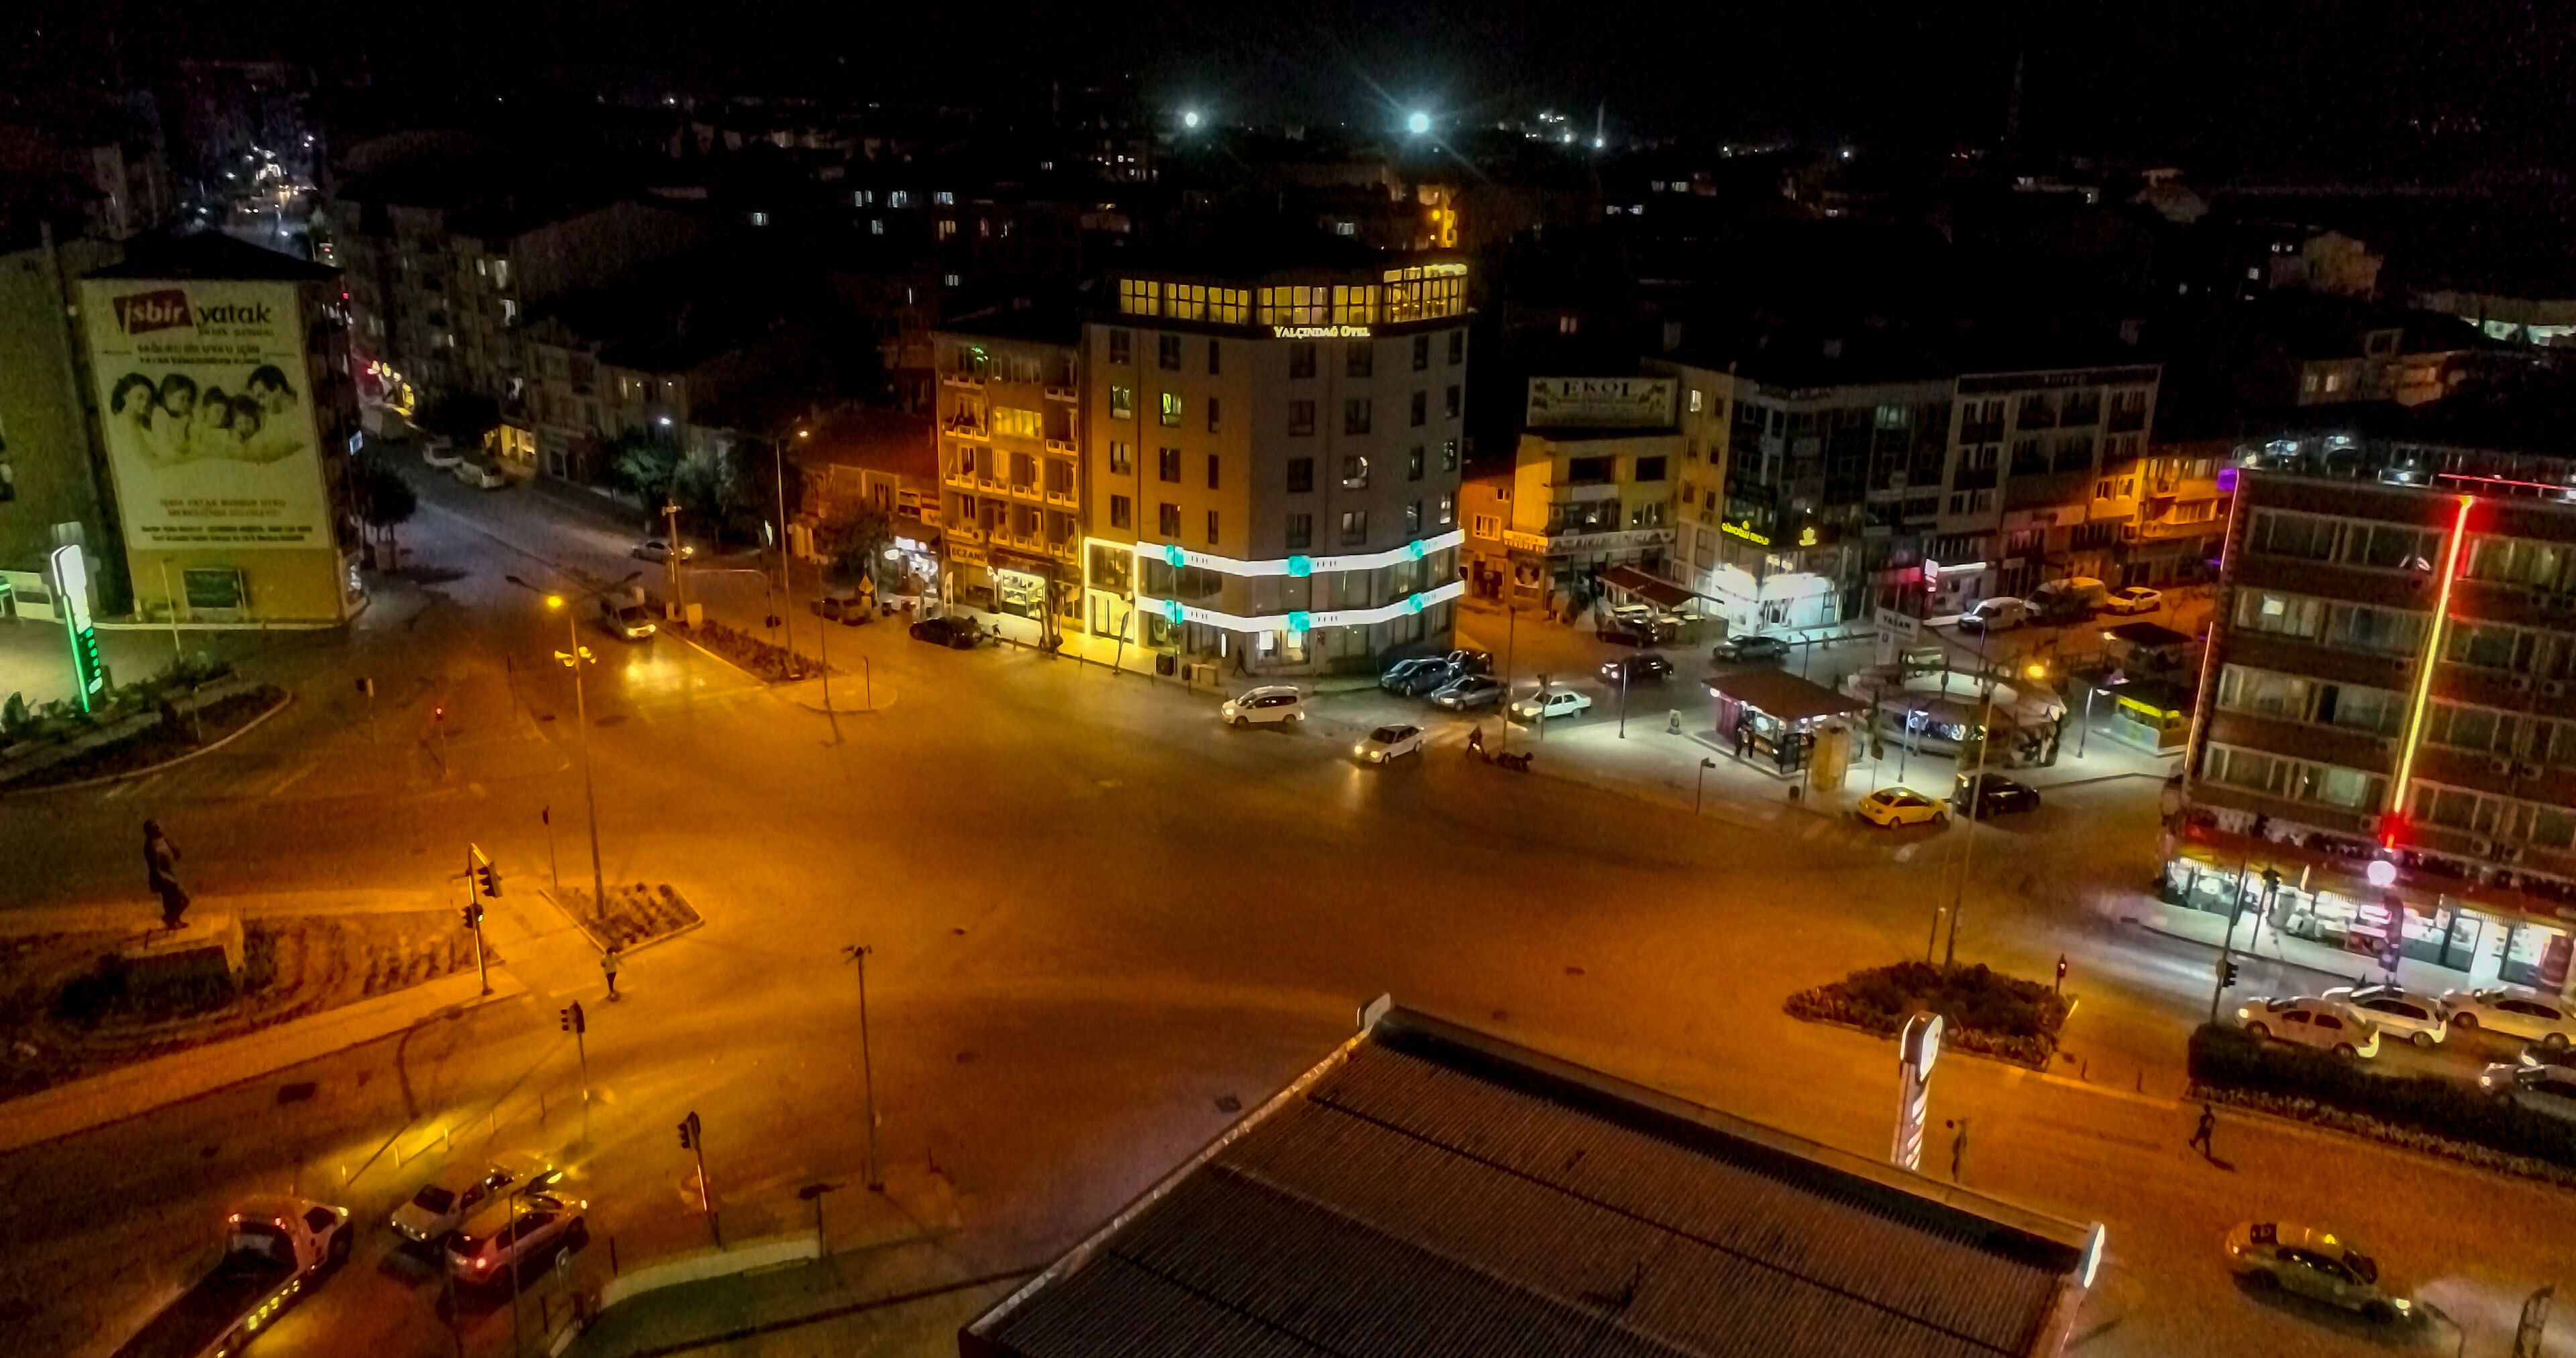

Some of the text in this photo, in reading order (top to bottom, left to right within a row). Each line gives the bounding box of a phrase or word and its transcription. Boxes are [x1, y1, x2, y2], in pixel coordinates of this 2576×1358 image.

[196, 301, 270, 329] yatak
[1273, 325, 1371, 339] YALÇINDAĞ OTEL
[1563, 381, 1635, 397] EKOL
